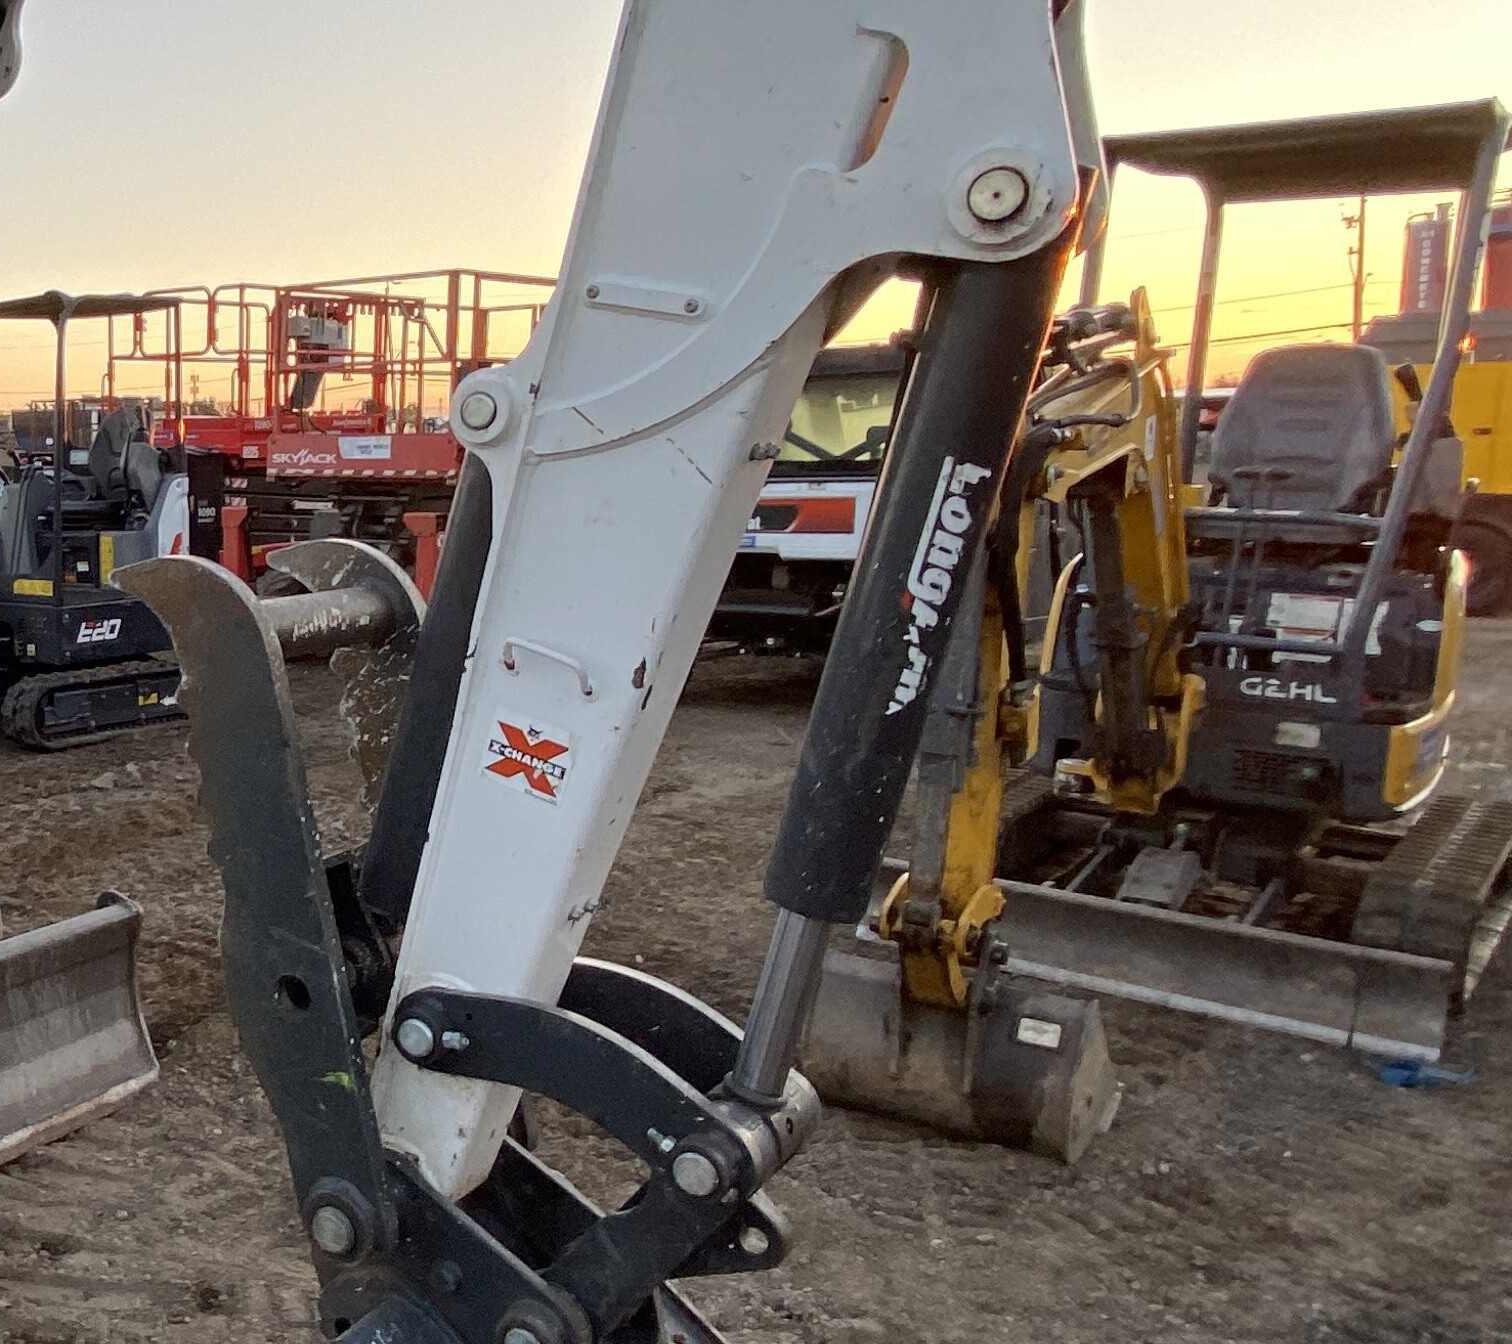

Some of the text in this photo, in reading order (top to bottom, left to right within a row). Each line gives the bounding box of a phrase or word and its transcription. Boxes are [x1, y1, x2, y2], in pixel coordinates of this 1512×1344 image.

[271, 449, 337, 466] SKYJACK
[76, 619, 121, 643] E20
[1240, 677, 1337, 703] GEHL
[490, 741, 564, 778] X-CHANGE
